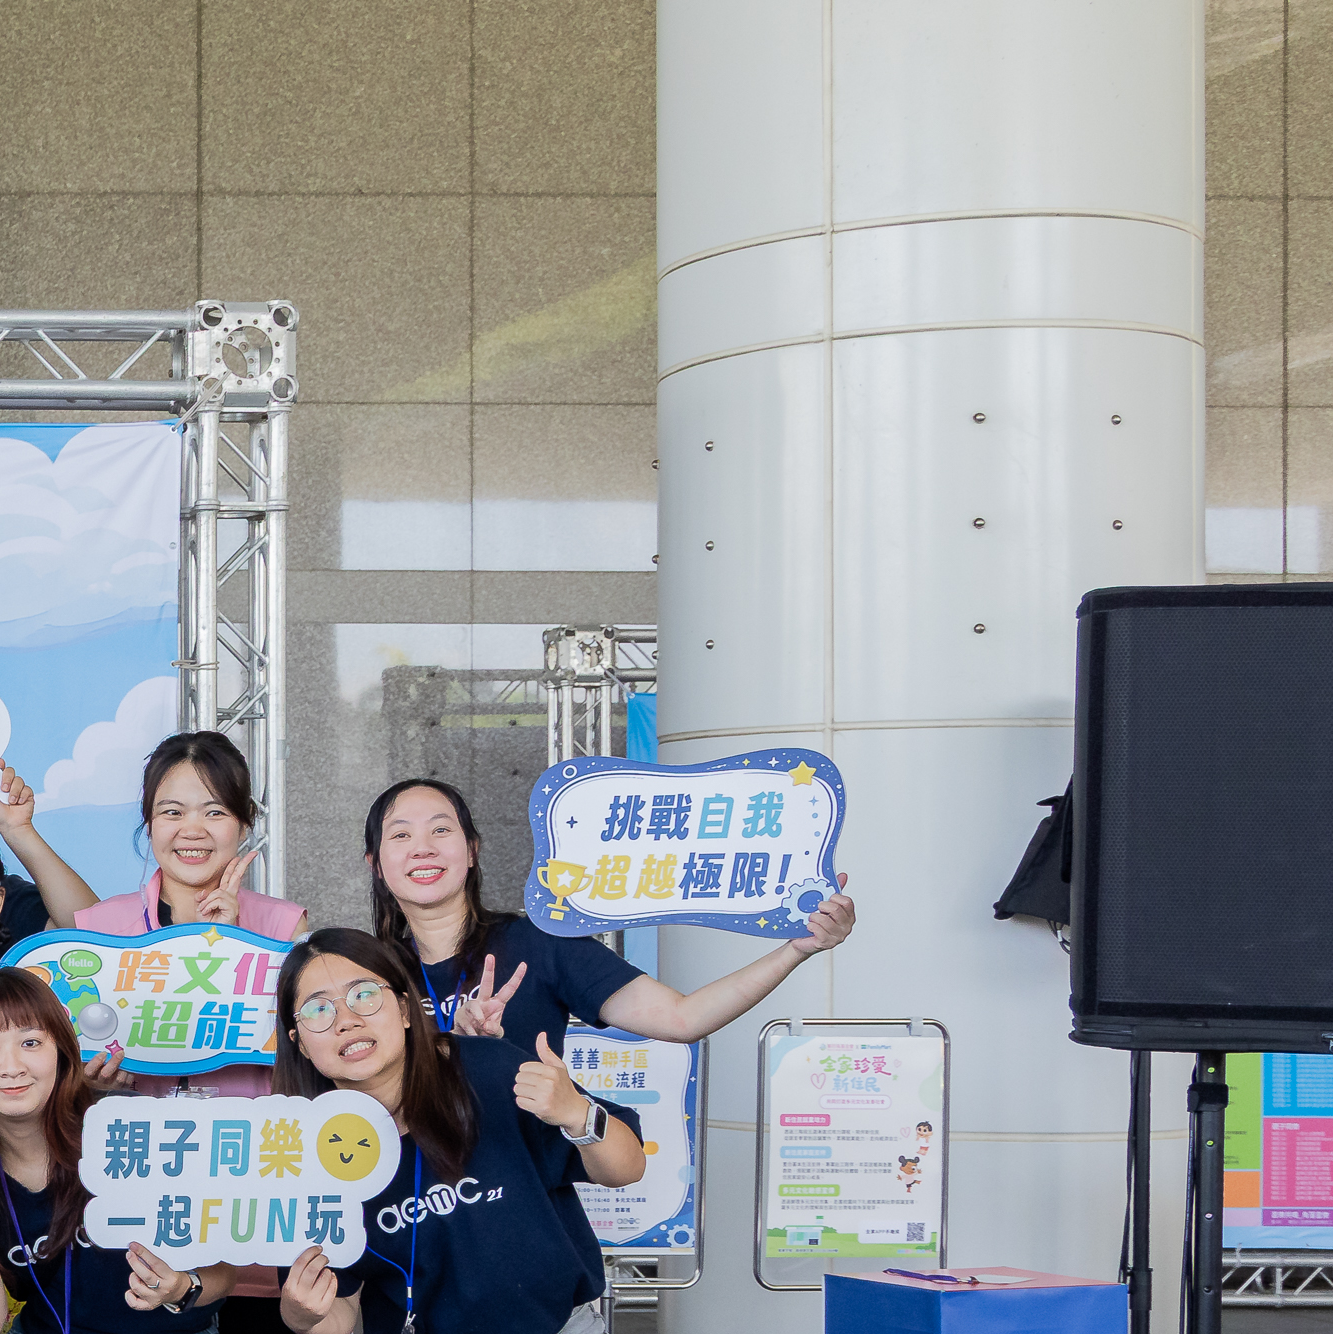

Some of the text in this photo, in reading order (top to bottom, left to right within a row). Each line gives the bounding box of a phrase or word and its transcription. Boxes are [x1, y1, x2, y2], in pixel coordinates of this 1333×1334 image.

[600, 791, 785, 842] 挑戰自我
[588, 852, 793, 900] 超越極限!
[68, 957, 94, 968] Hello
[113, 951, 280, 996] 跨文化
[571, 1048, 650, 1069] 善善聯手區
[819, 1054, 892, 1076] 全家珍愛
[832, 1075, 881, 1092] 新住民
[104, 1118, 304, 1179] 親子同樂
[107, 1195, 345, 1248] 一起FUN玩
[377, 1177, 503, 1233] aemc 21
